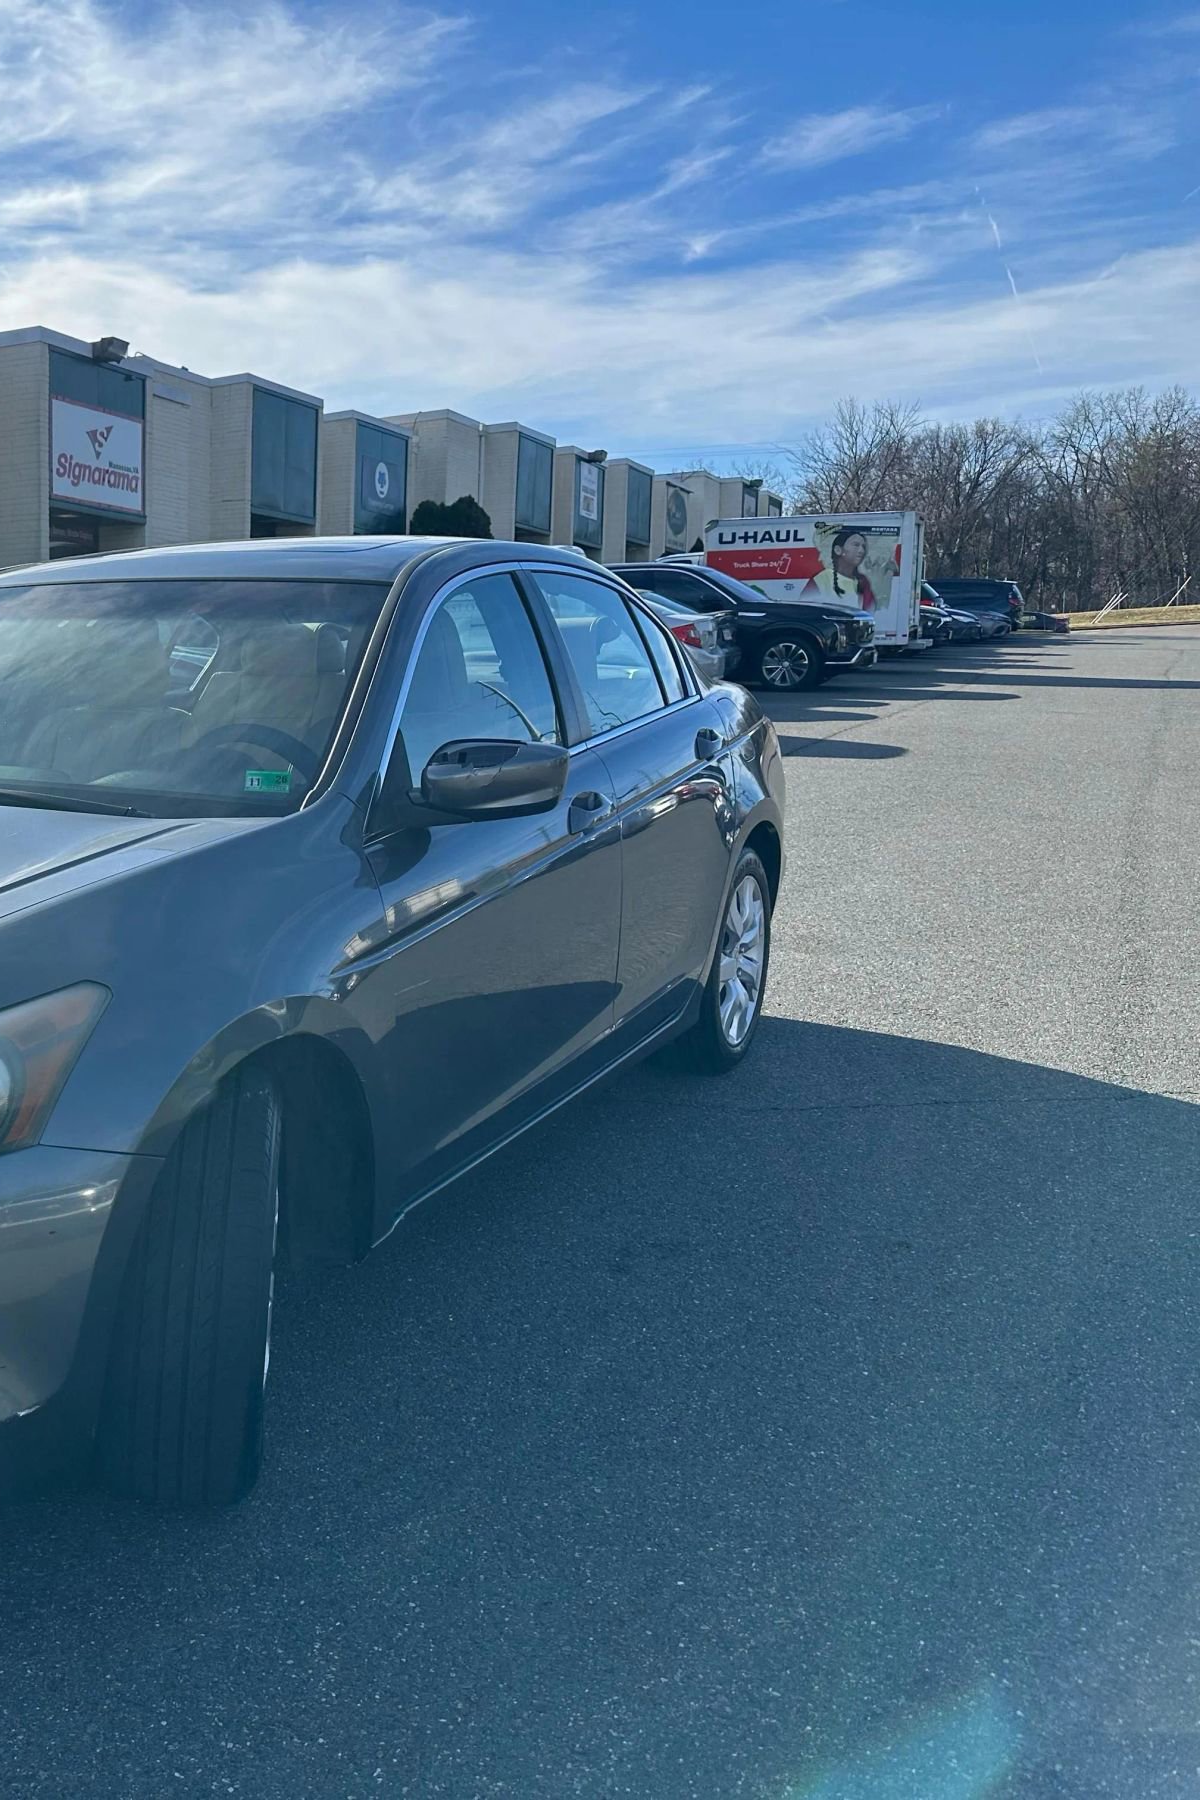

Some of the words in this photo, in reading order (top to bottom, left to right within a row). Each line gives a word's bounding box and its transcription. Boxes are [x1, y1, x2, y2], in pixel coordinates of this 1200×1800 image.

[55, 452, 140, 494] Signarama
[718, 529, 805, 545] U-HAUL
[249, 777, 260, 786] 11
